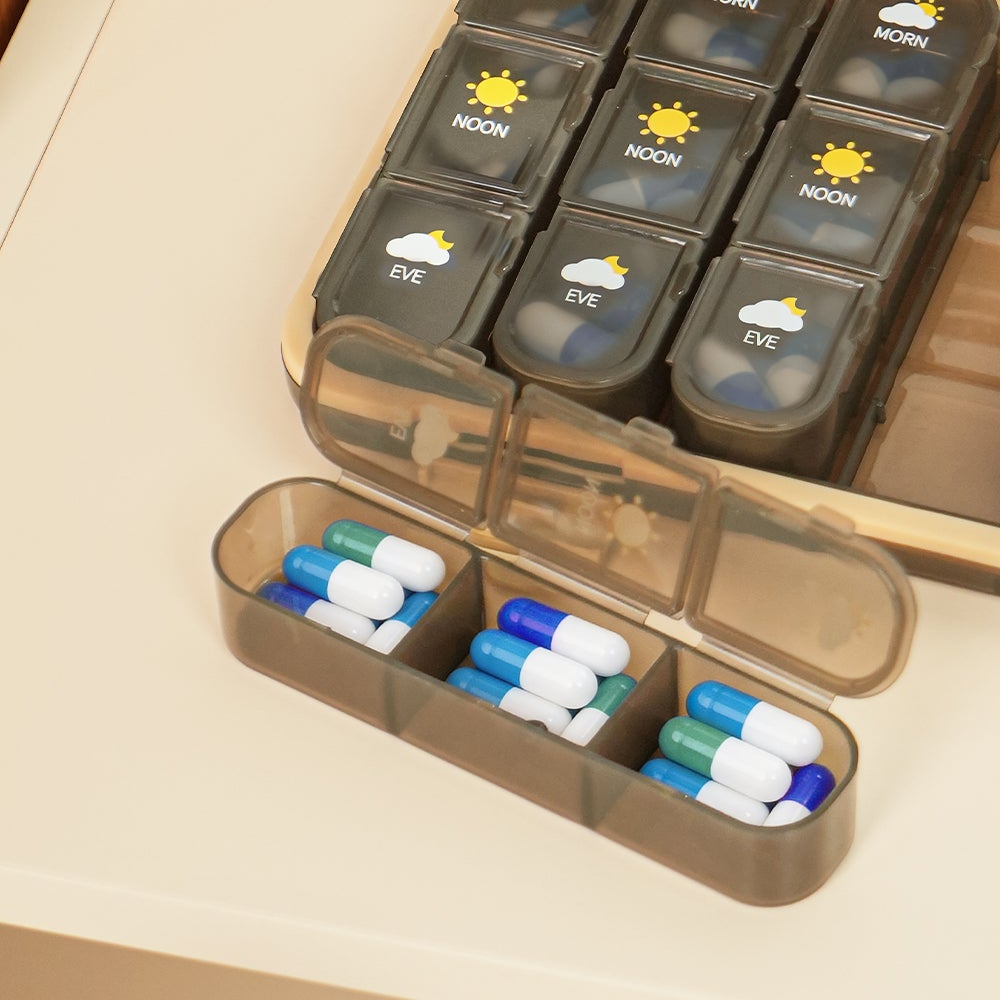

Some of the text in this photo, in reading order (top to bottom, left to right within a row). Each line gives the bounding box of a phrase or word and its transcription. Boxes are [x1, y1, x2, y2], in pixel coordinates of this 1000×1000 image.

[874, 26, 929, 48] MORN
[452, 114, 510, 138] NOON
[625, 144, 682, 167] NOON
[799, 184, 857, 207] NOON
[389, 264, 426, 284] EVE
[565, 289, 601, 307] EVE
[743, 330, 780, 349] EVE
